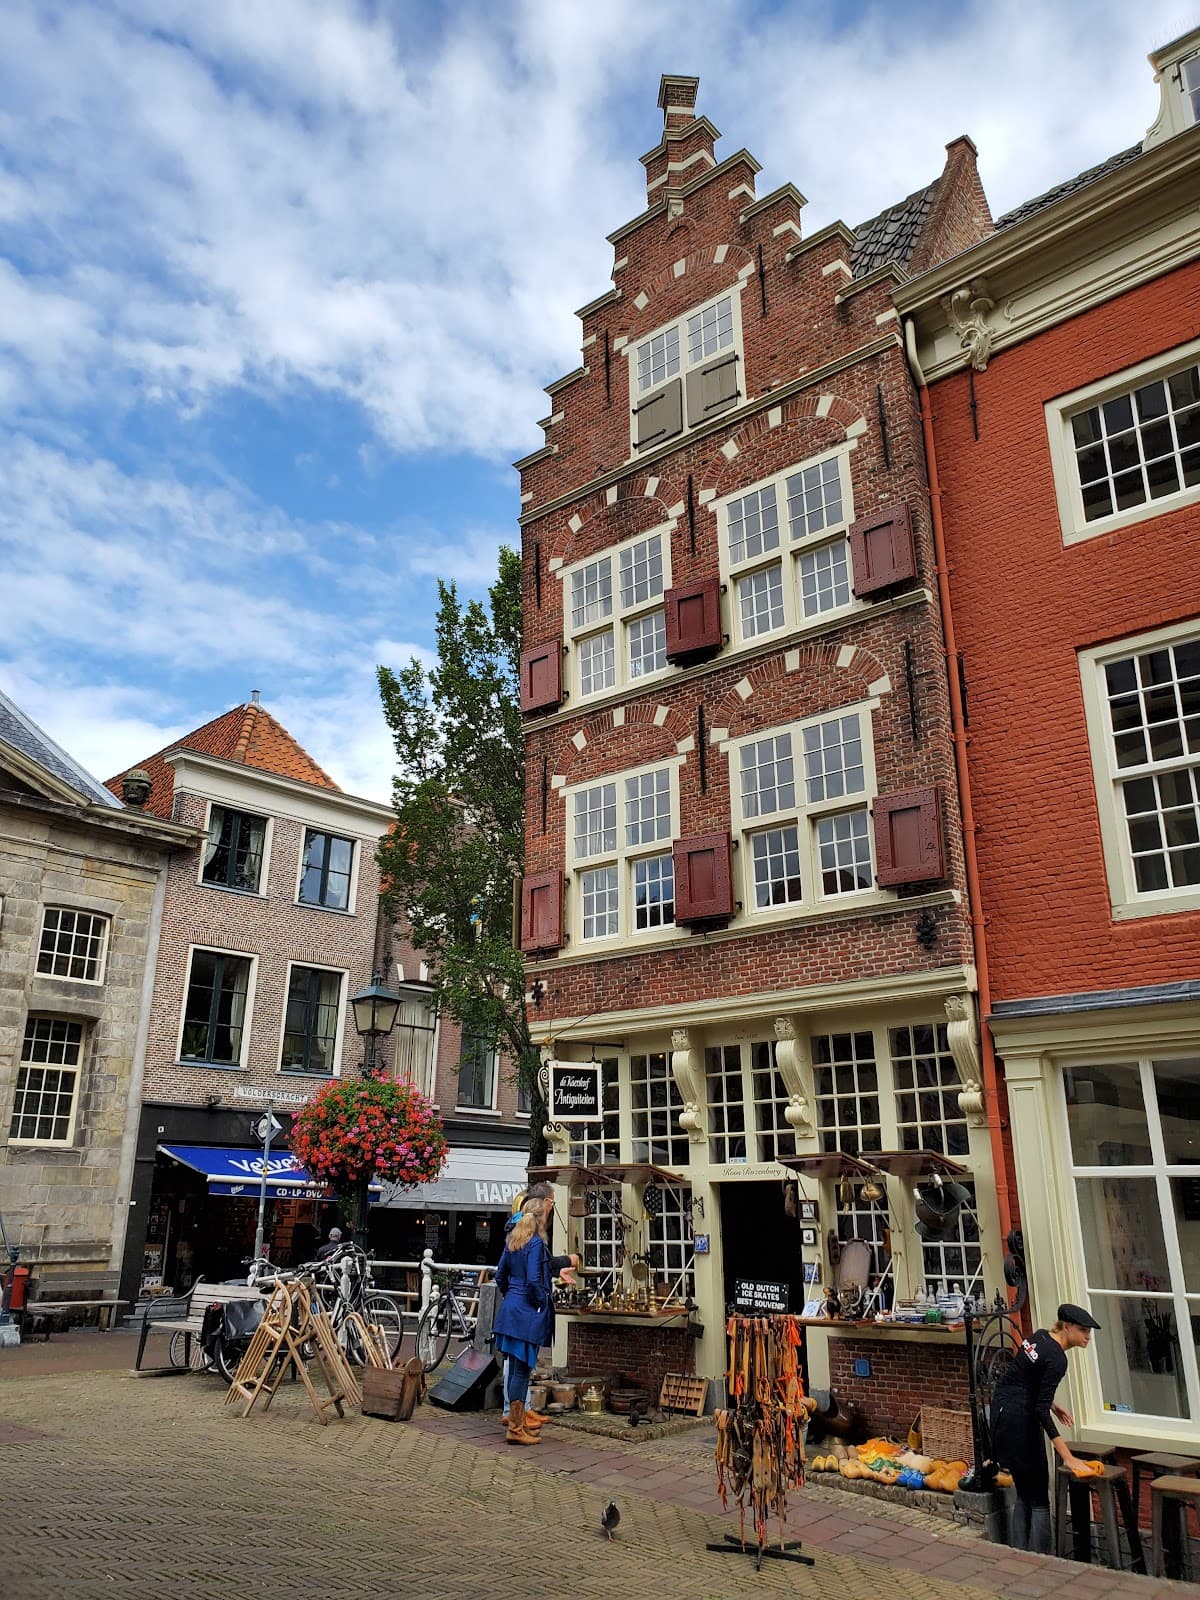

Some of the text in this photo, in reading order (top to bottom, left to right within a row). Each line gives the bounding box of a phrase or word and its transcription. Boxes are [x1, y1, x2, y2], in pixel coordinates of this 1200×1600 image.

[242, 1086, 305, 1101] VOLDERSGRACHT
[554, 1088, 595, 1109] Antiquiteiten
[276, 1187, 287, 1196] CD
[292, 1189, 302, 1197] LP
[475, 1182, 526, 1203] HAPP
[741, 1282, 780, 1293] OLD DUTCH
[741, 1290, 780, 1301] ICE SKATES
[736, 1297, 753, 1306] BEST
